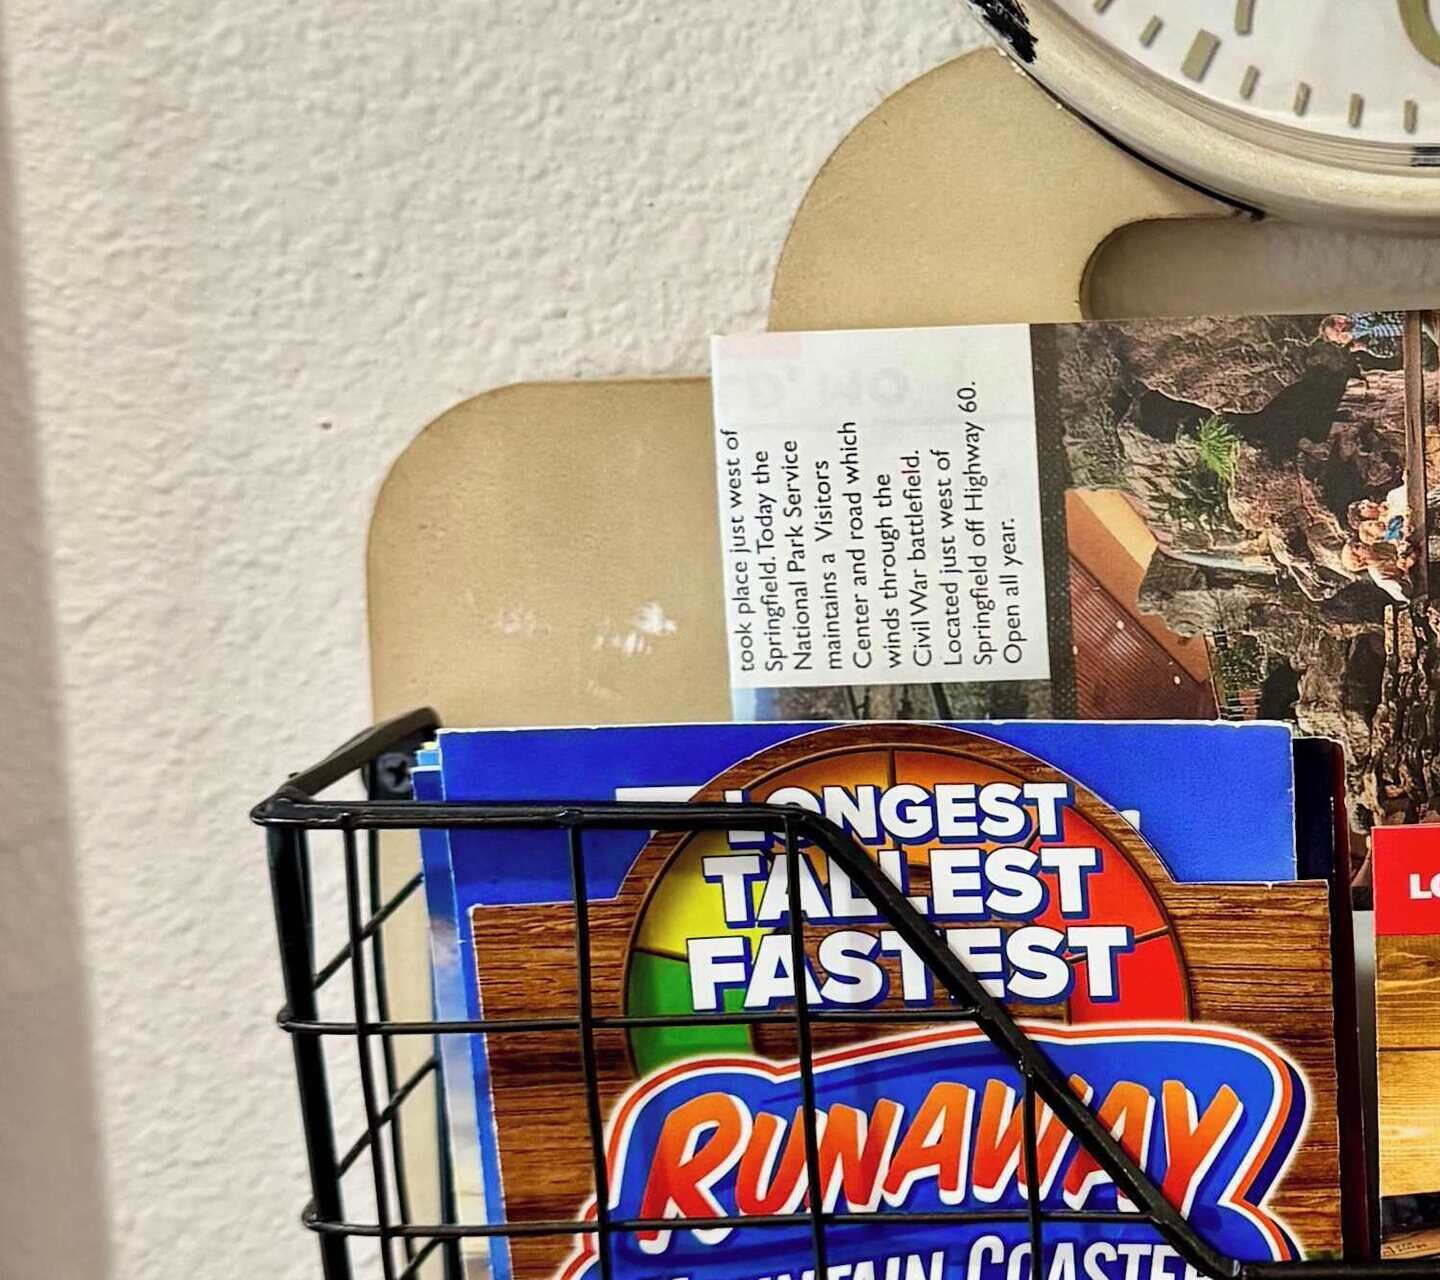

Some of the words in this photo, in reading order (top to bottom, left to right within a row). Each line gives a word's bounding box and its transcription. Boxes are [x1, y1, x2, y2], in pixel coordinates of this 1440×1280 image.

[956, 381, 978, 414] 60.
[719, 428, 739, 451] of
[836, 421, 861, 485] which
[928, 448, 951, 472] of
[961, 420, 989, 512] Highway
[726, 457, 743, 509] west
[750, 450, 771, 485] the
[780, 440, 803, 518] Service
[871, 473, 893, 509] the
[753, 492, 778, 555] Today
[813, 459, 834, 543] Visitors
[841, 491, 865, 541] road
[899, 449, 927, 561] battlefield.
[936, 477, 955, 530] west
[729, 515, 752, 554] just
[783, 524, 807, 573] Park
[821, 553, 836, 564] a
[873, 516, 901, 600] through
[938, 535, 964, 574] just
[964, 517, 986, 548] off
[1000, 517, 1024, 567] year.
[731, 561, 757, 615] place
[844, 548, 868, 587] and
[908, 568, 929, 617] War
[998, 574, 1020, 597] all
[757, 552, 789, 672] Springfield.
[787, 580, 813, 671] National
[819, 571, 843, 670] maintains
[852, 593, 873, 670] Center
[938, 581, 963, 666] Located
[966, 555, 999, 666] Springfield
[1002, 604, 1028, 665] Open
[733, 622, 755, 672] took
[879, 607, 902, 669] winds
[909, 620, 933, 668] Civil
[686, 926, 1130, 1009] FASTEST
[636, 1077, 1242, 1254] RUNAWAY
